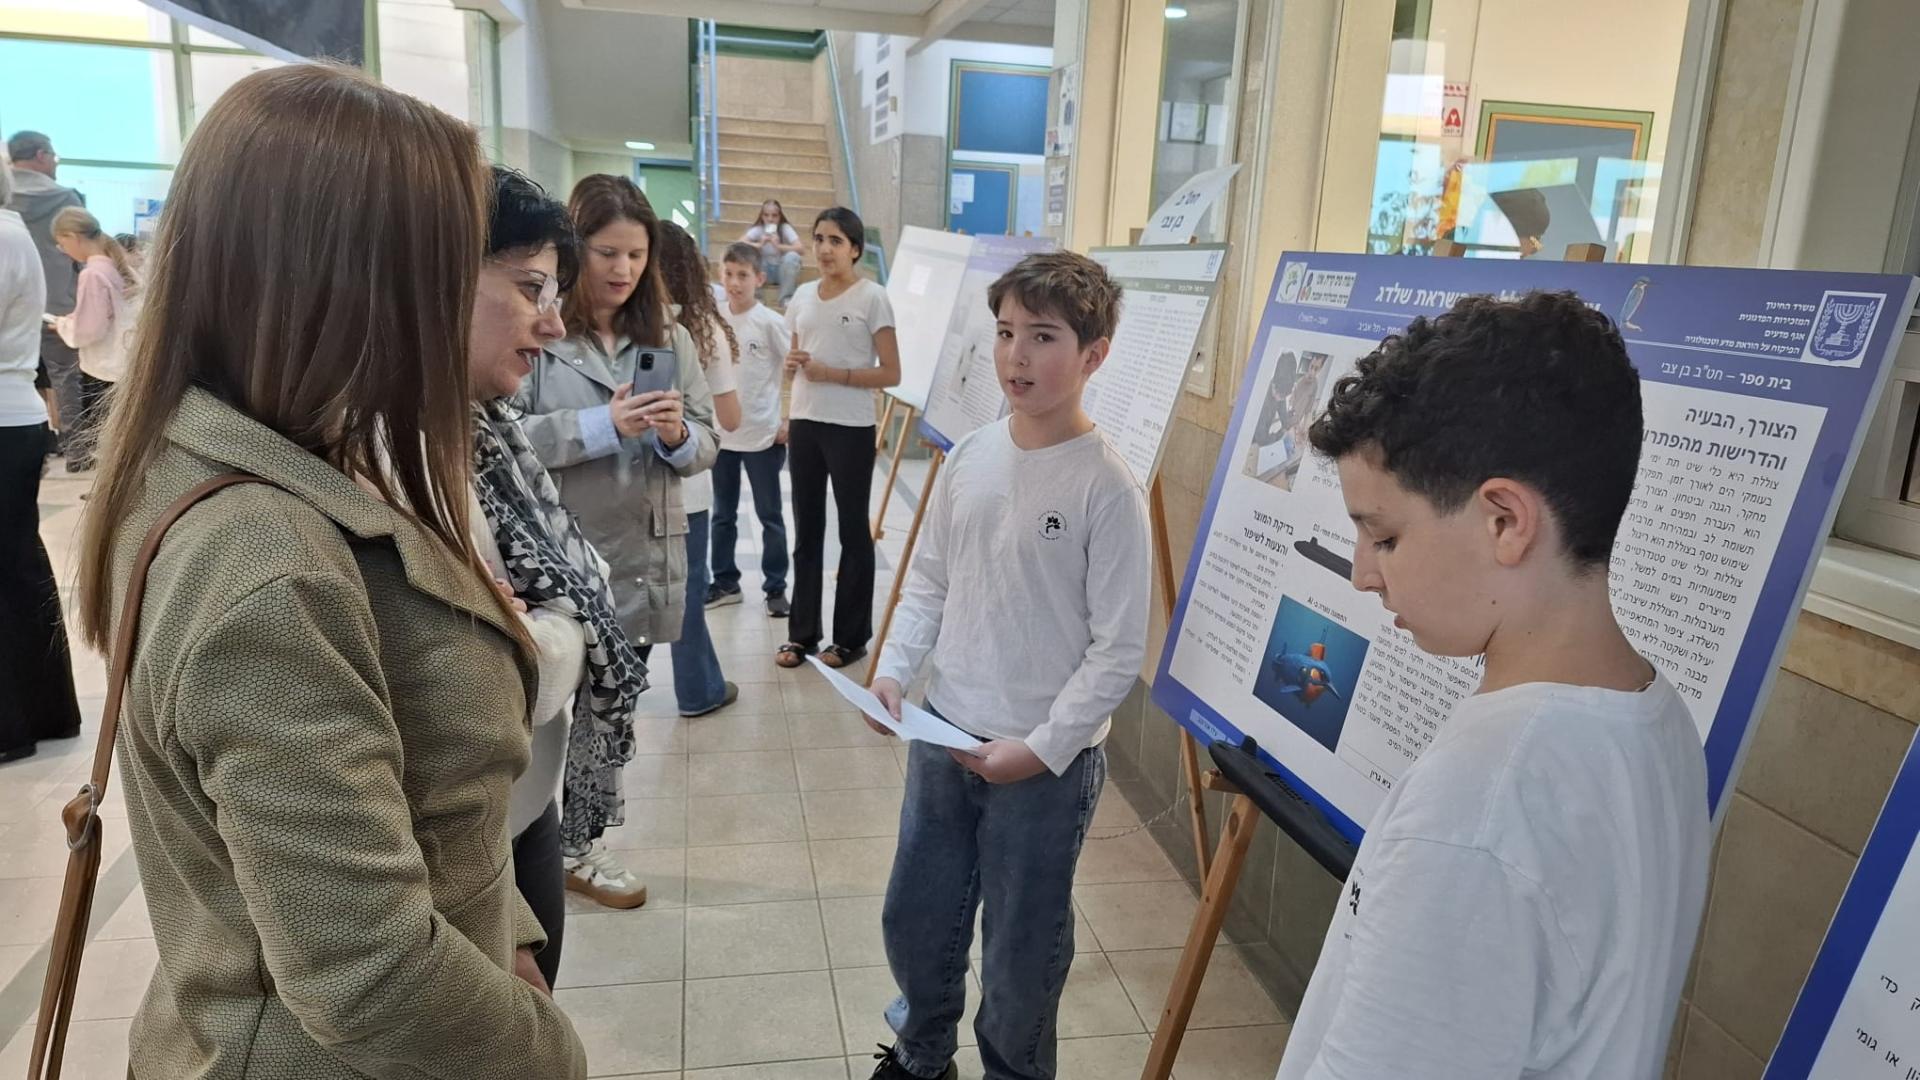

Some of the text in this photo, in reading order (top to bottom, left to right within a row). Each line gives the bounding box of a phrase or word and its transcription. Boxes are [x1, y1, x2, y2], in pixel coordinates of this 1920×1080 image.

[1375, 282, 1413, 305] שלדג
[1413, 288, 1469, 309] שראת
[1765, 301, 1816, 312] משרד החינוך
[1738, 313, 1810, 326] המזכירות הפדגוגית
[1719, 338, 1735, 347] מדע
[1764, 329, 1806, 341] אגף מדעים
[1734, 340, 1760, 350] הוראת
[1760, 341, 1771, 351] על
[1771, 344, 1801, 354] הפיקוח
[1660, 361, 1677, 376] צבי
[1678, 365, 1691, 379] בן
[1694, 364, 1724, 382] חט"ב
[1739, 372, 1765, 388] ספר
[1767, 376, 1793, 391] בית
[1685, 408, 1797, 440] הצורך, הבעיה
[1641, 430, 1787, 470] והדרישות מהפתרו
[1650, 454, 1779, 490] צוללת היא כלי שיט תת ימי
[1646, 485, 1668, 497] הצורך
[1690, 479, 1714, 492] לאורך
[1718, 486, 1735, 497] הים
[1741, 491, 1772, 506] בעומקי
[1654, 504, 1664, 513] או
[1670, 508, 1697, 522] חפצים
[1709, 501, 1732, 514] הגנה
[1254, 510, 1272, 526] המוצר
[1704, 517, 1736, 532] העברת
[1272, 519, 1294, 536] בדיקת
[1659, 521, 1697, 539] ובמהירות
[1743, 527, 1761, 539] הוא
[1244, 527, 1288, 556] והצעות לשיפור
[1650, 535, 1666, 546] הוא
[1703, 533, 1716, 544] לב
[1624, 544, 1666, 563] סטנדרטיים
[1667, 540, 1696, 556] בצוללת
[1721, 539, 1755, 555] תשומת
[1699, 550, 1719, 563] נוסף
[1720, 556, 1749, 571] שימוש
[1670, 559, 1688, 570] שיט
[1693, 563, 1709, 577] וכלי
[1661, 572, 1682, 586] במים
[1713, 572, 1743, 588] צוללות
[1633, 579, 1660, 595] ותנועת
[1688, 581, 1737, 604] משמעותיות
[1670, 592, 1688, 605] רעש
[1616, 606, 1659, 628] המתאפיינת
[1648, 602, 1679, 619] הצוללת
[1698, 602, 1731, 620] מייצרים
[1664, 623, 1685, 638] ציפור
[1642, 633, 1659, 645] ללא
[1659, 640, 1689, 658] ושקטה
[1690, 652, 1714, 666] יעילה
[1684, 667, 1708, 684] מבנה
[1881, 975, 1898, 994] כדי
[1857, 1028, 1900, 1067] או גומי
